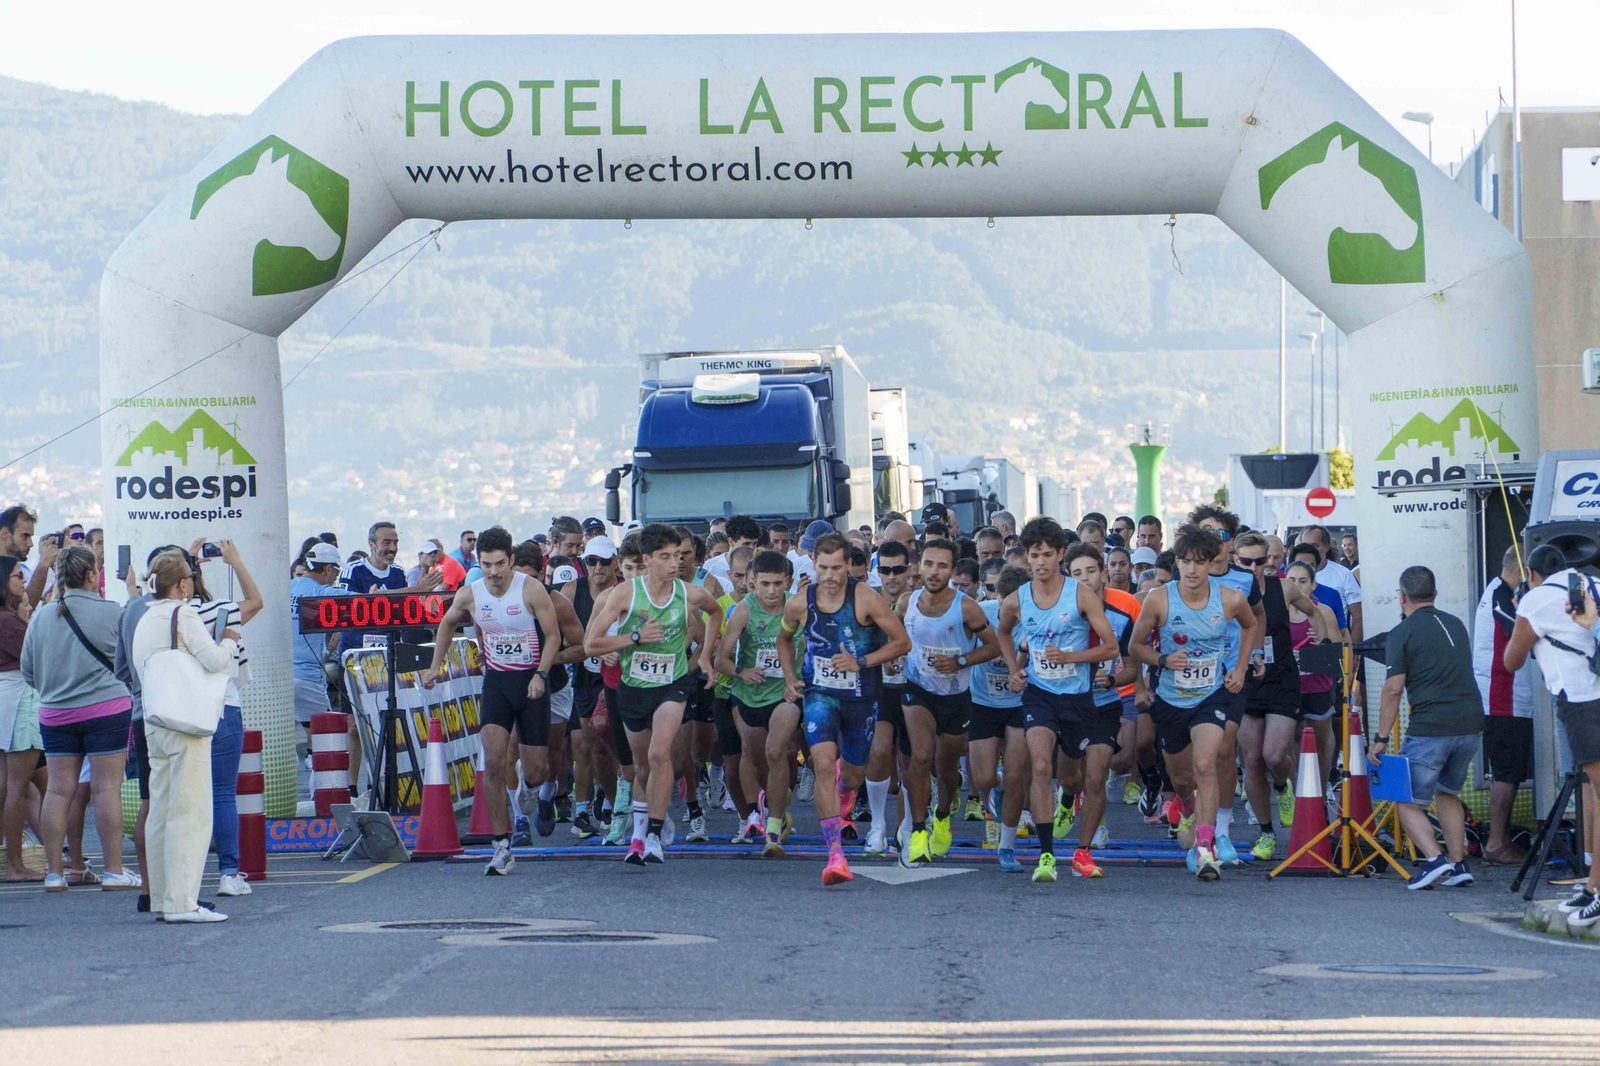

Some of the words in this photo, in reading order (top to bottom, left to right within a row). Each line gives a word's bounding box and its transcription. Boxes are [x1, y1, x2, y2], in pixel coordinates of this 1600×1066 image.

[405, 79, 647, 137] HOTEL
[700, 76, 784, 135] LA
[405, 146, 853, 184] www.hotelrectoral.com
[747, 360, 772, 368] KING
[1377, 457, 1467, 487] rode
[116, 465, 257, 508] rodespi
[1392, 498, 1467, 513] www.rode
[127, 507, 243, 523] www.rodespi.es
[319, 594, 444, 628] 0:00:00
[495, 643, 523, 655] 524
[640, 660, 667, 674] 611
[764, 658, 781, 669] 50
[821, 667, 848, 680] 541
[1182, 667, 1210, 679] 510
